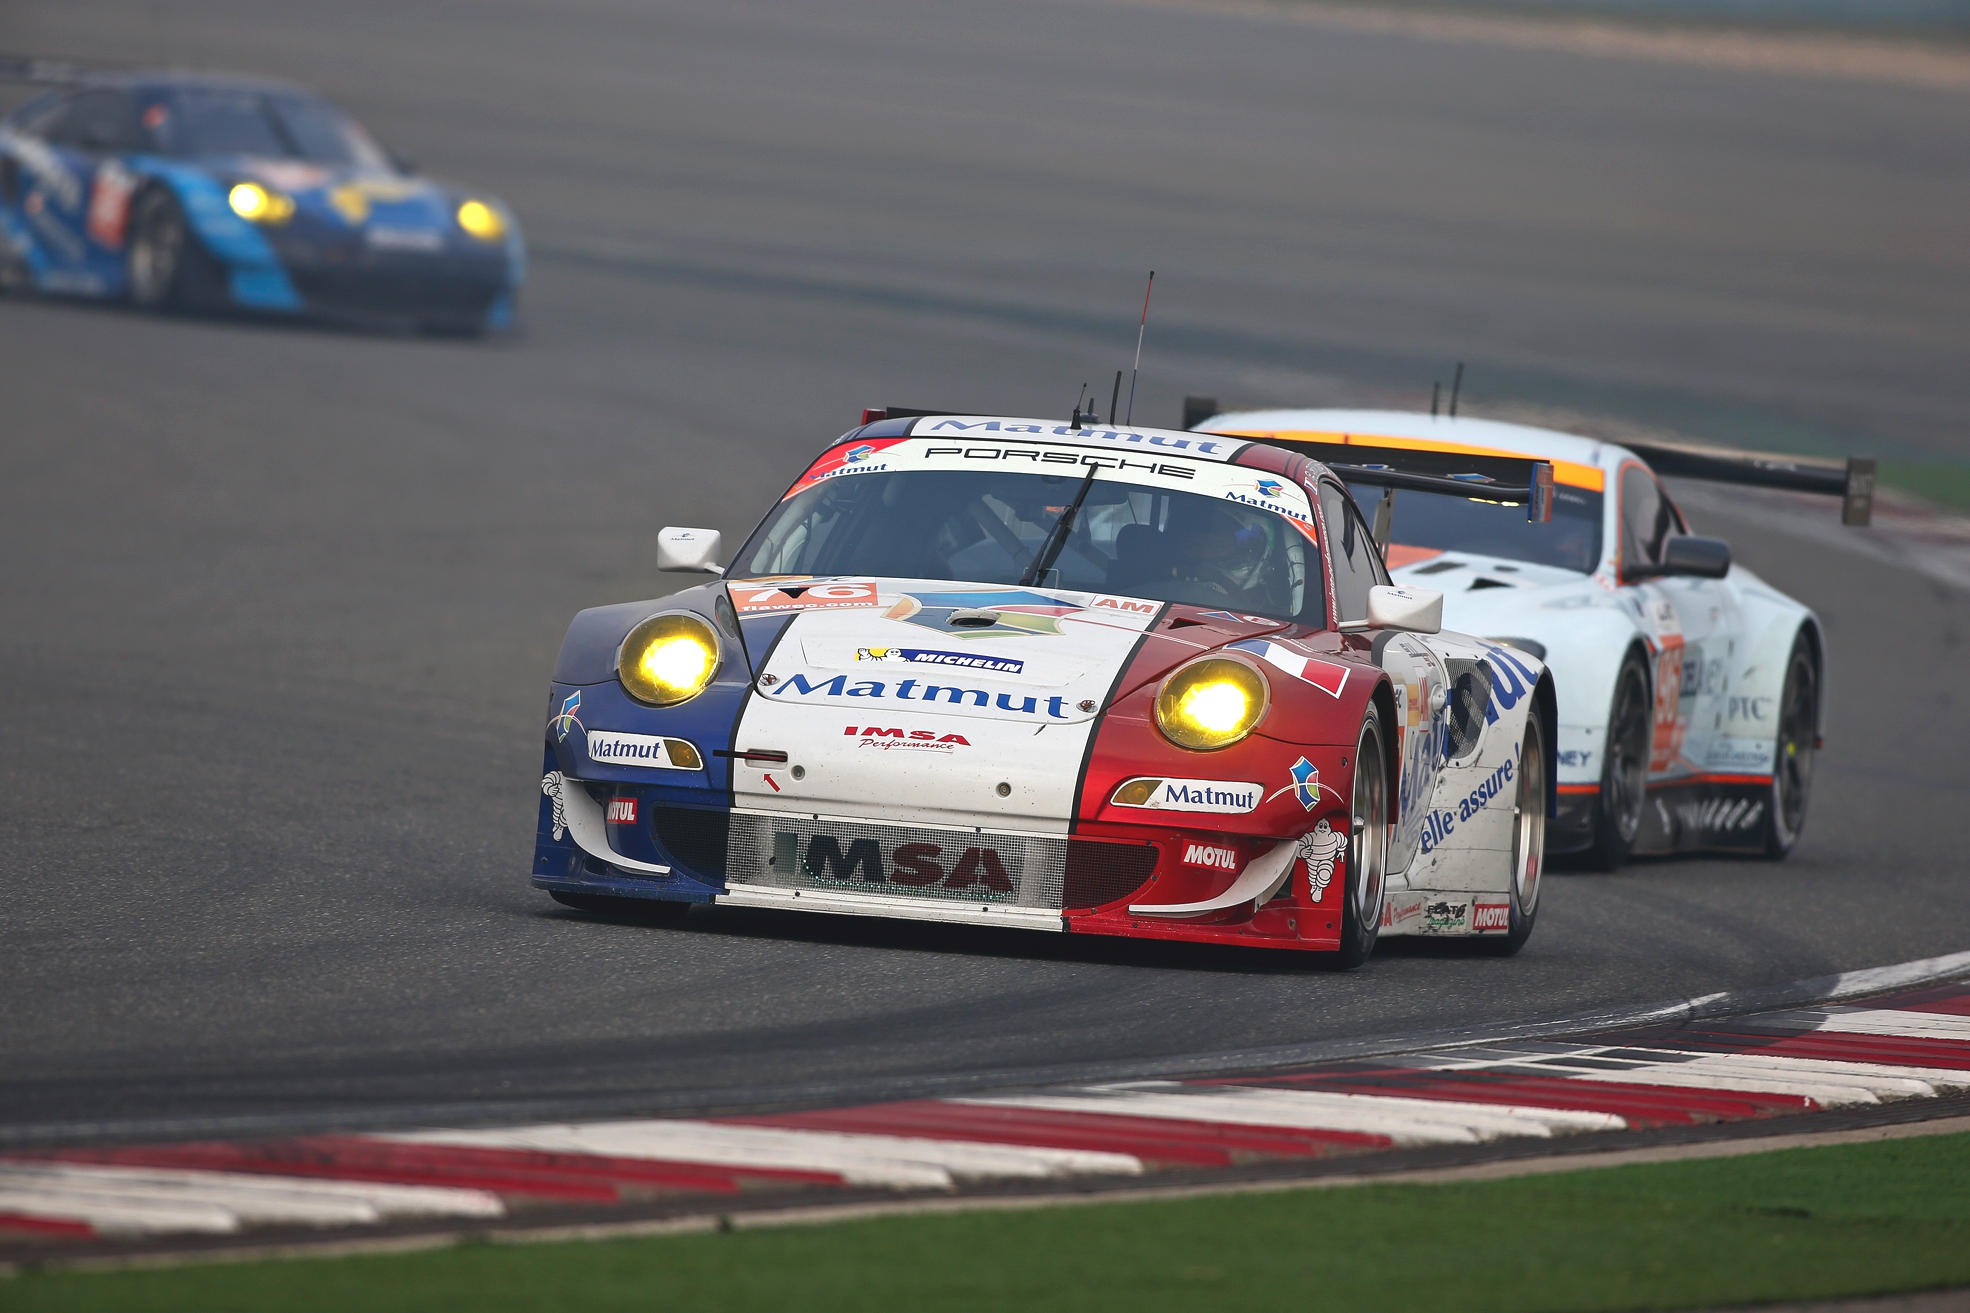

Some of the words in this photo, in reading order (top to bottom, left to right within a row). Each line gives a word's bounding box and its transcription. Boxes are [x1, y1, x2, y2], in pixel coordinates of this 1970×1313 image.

[930, 419, 1224, 455] Matmut
[924, 447, 1197, 480] PORSCHE
[1225, 491, 1308, 522] Matmut
[734, 584, 873, 602] 76
[1094, 598, 1154, 613] AM
[913, 652, 1022, 673] MICHELIN
[771, 673, 1070, 719] Matmut
[843, 726, 972, 746] IMSA
[858, 738, 955, 750] Performance
[591, 739, 661, 759] Matmut
[1165, 784, 1254, 809] Matmut
[1421, 809, 1455, 853] elle
[1459, 758, 1514, 822] assure
[772, 831, 1015, 893] IMSA
[1183, 844, 1236, 870] MOTUL
